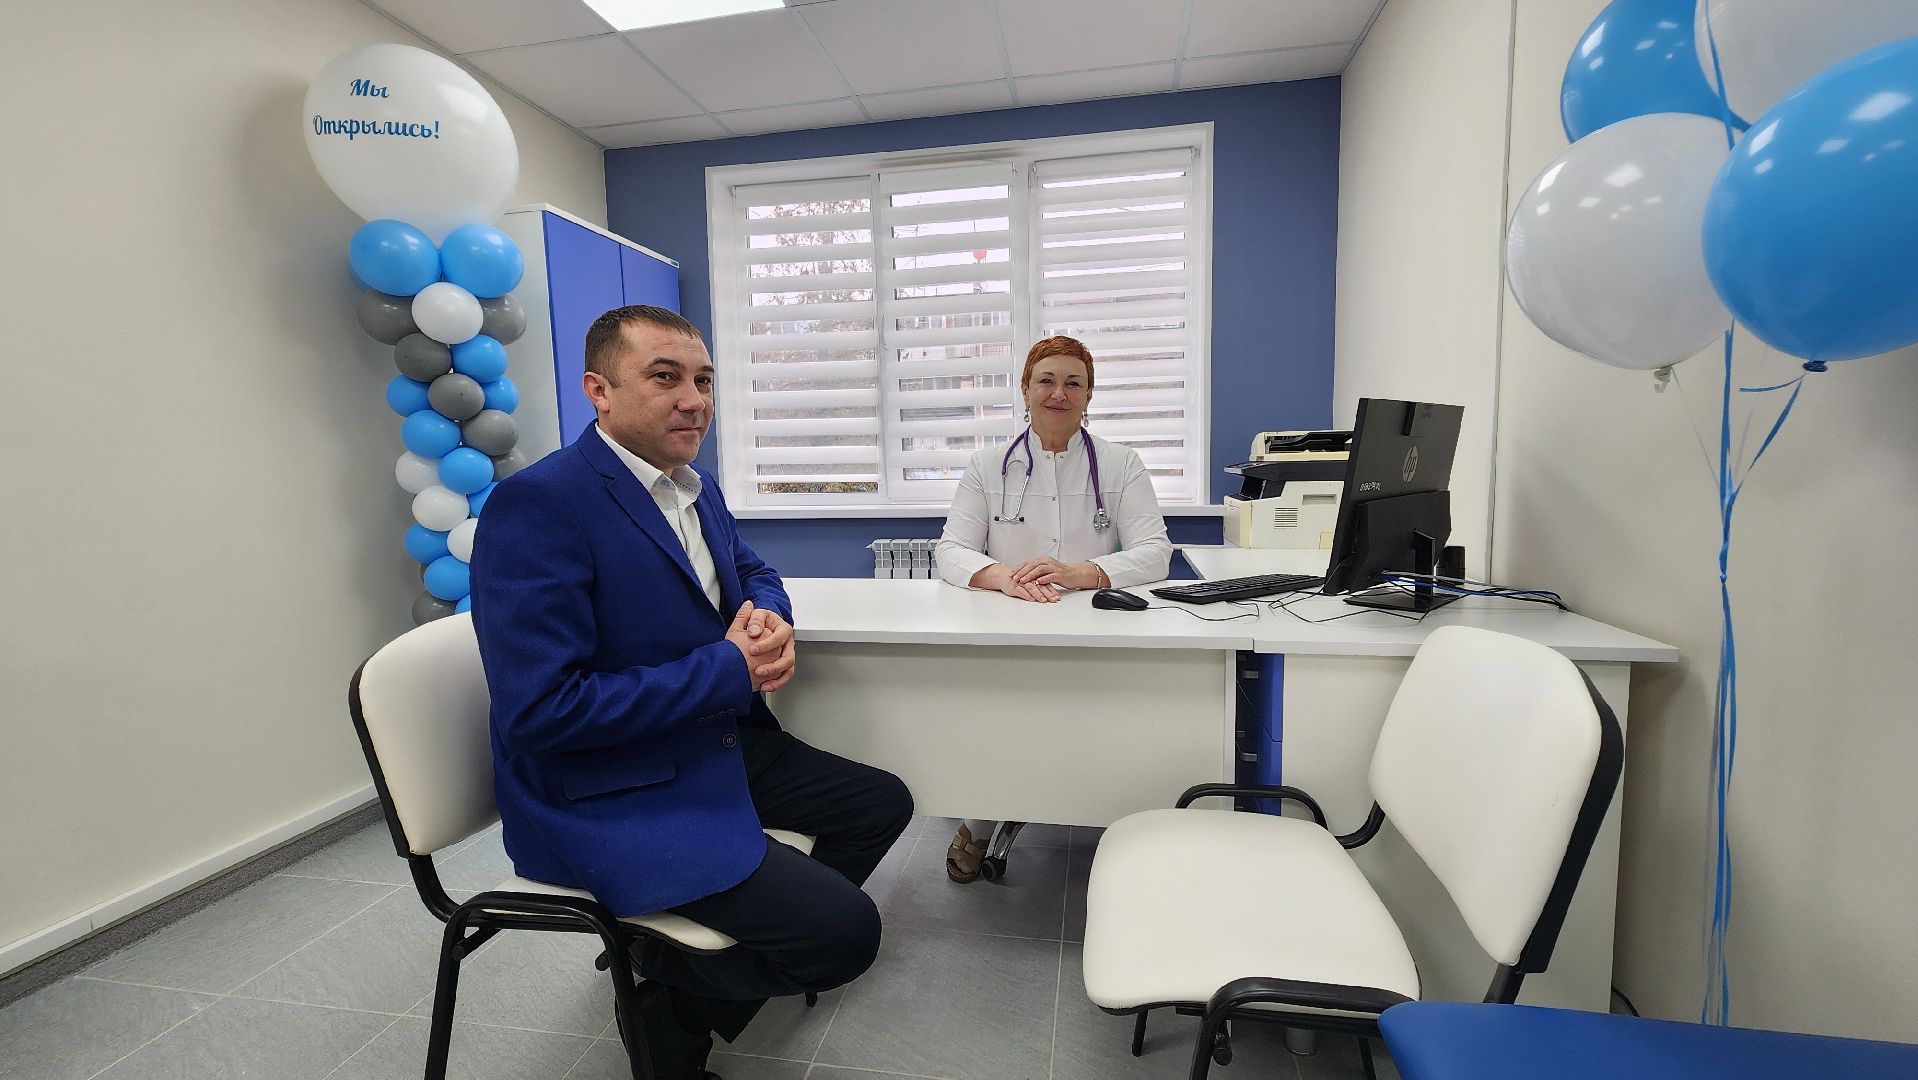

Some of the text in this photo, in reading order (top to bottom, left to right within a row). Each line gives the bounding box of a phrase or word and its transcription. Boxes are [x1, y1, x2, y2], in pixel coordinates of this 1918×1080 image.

[350, 78, 390, 98] Мы
[312, 114, 440, 141] Открылись!
[1403, 446, 1418, 482] hp
